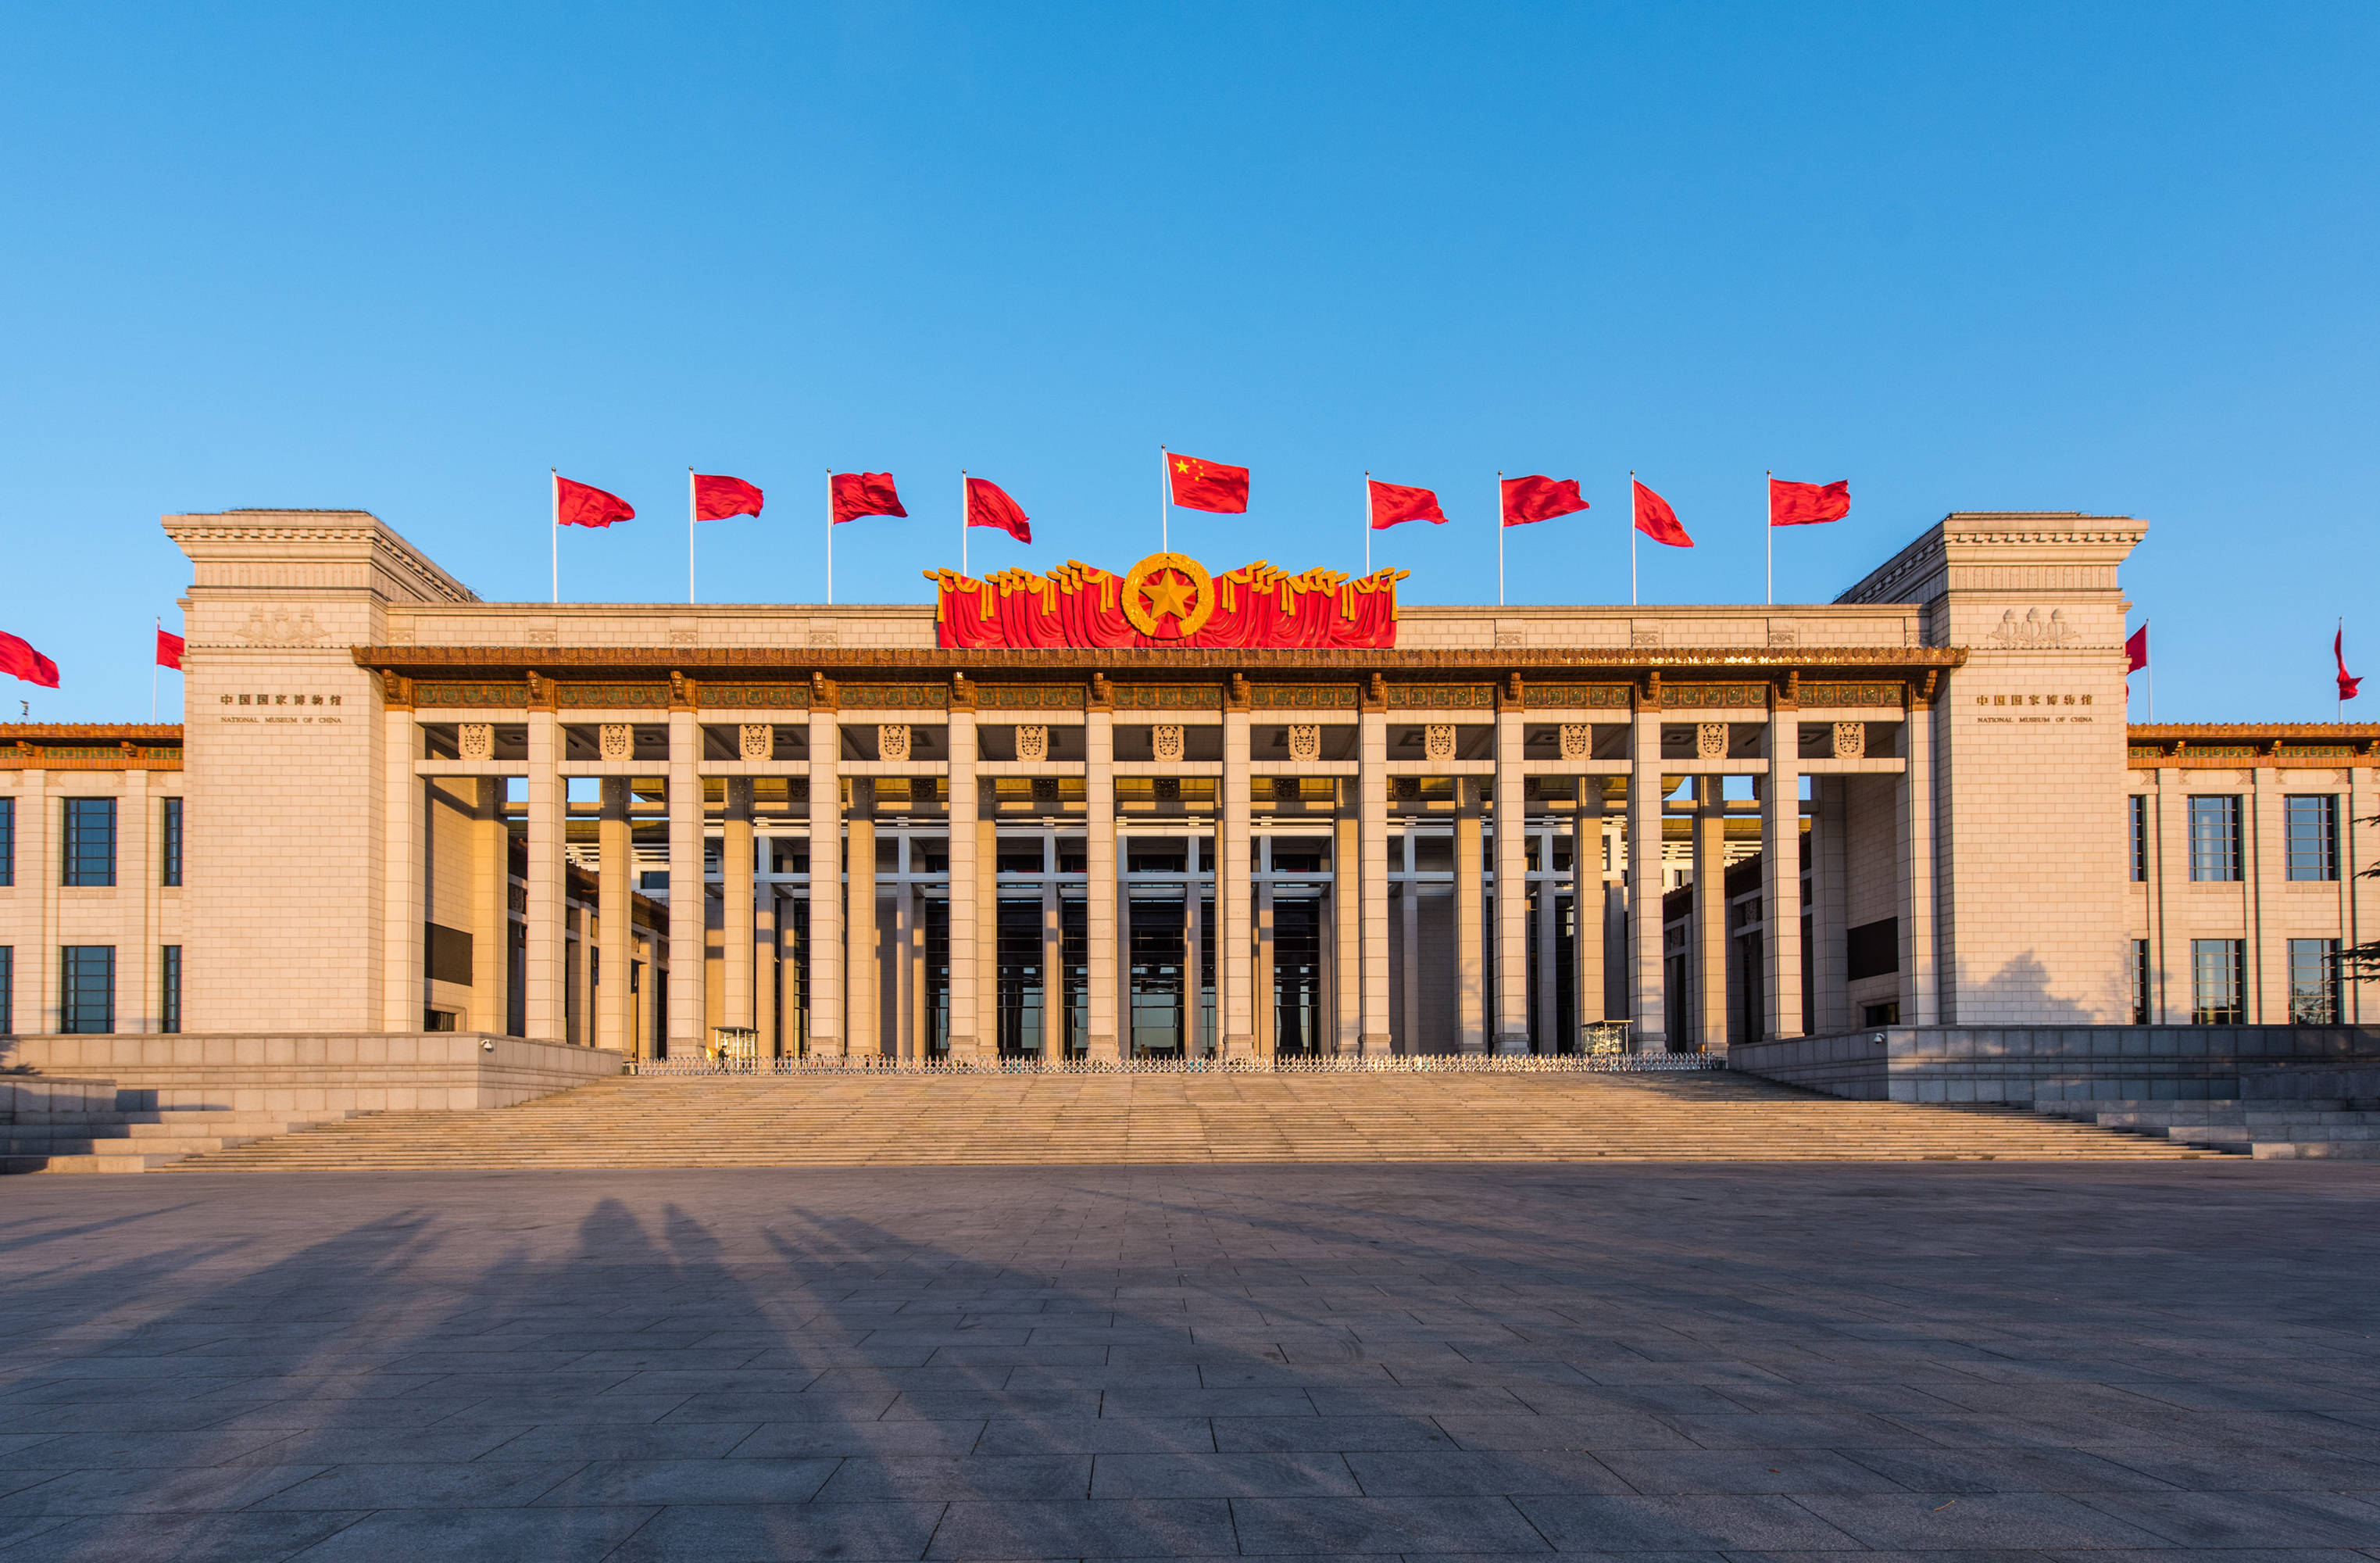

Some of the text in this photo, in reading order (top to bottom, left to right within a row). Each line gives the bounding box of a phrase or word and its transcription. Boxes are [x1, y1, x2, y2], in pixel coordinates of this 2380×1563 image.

[220, 694, 341, 706] 中国国家博物馆
[1977, 694, 2092, 706] 中国国家博物馆
